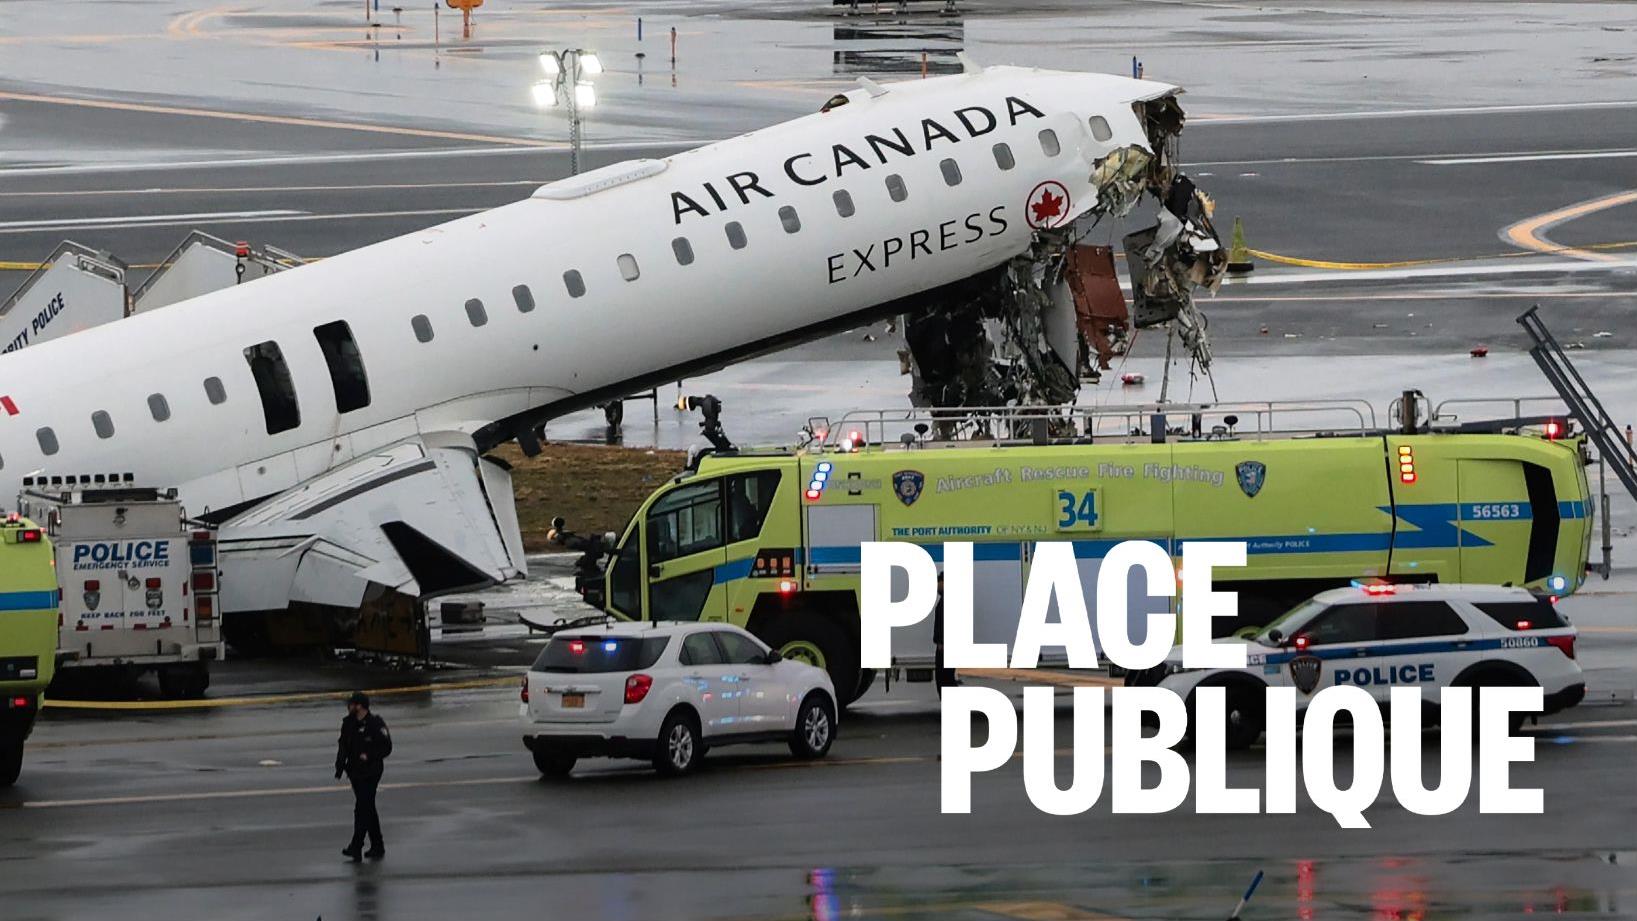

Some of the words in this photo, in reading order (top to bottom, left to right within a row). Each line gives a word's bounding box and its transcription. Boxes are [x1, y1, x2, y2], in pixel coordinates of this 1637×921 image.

[670, 170, 775, 225] AIR
[783, 95, 1046, 187] CANADA
[828, 205, 1008, 284] EXPRESS
[2, 327, 29, 354] RITY
[32, 292, 65, 336] POLICE
[935, 468, 1012, 494] Aircraft
[1020, 464, 1090, 482] Rescue
[1098, 463, 1135, 480] Fire
[1143, 463, 1225, 487] Fighting
[1058, 491, 1098, 528] 34
[1472, 504, 1520, 518] 56563
[892, 527, 911, 536] THE
[912, 527, 936, 536] PORT
[938, 526, 992, 536] AUTHORITY
[73, 541, 169, 563] POLICE
[73, 562, 130, 571] EMERGENCY
[132, 560, 170, 569] SERVICE
[1334, 664, 1435, 686] POLICE
